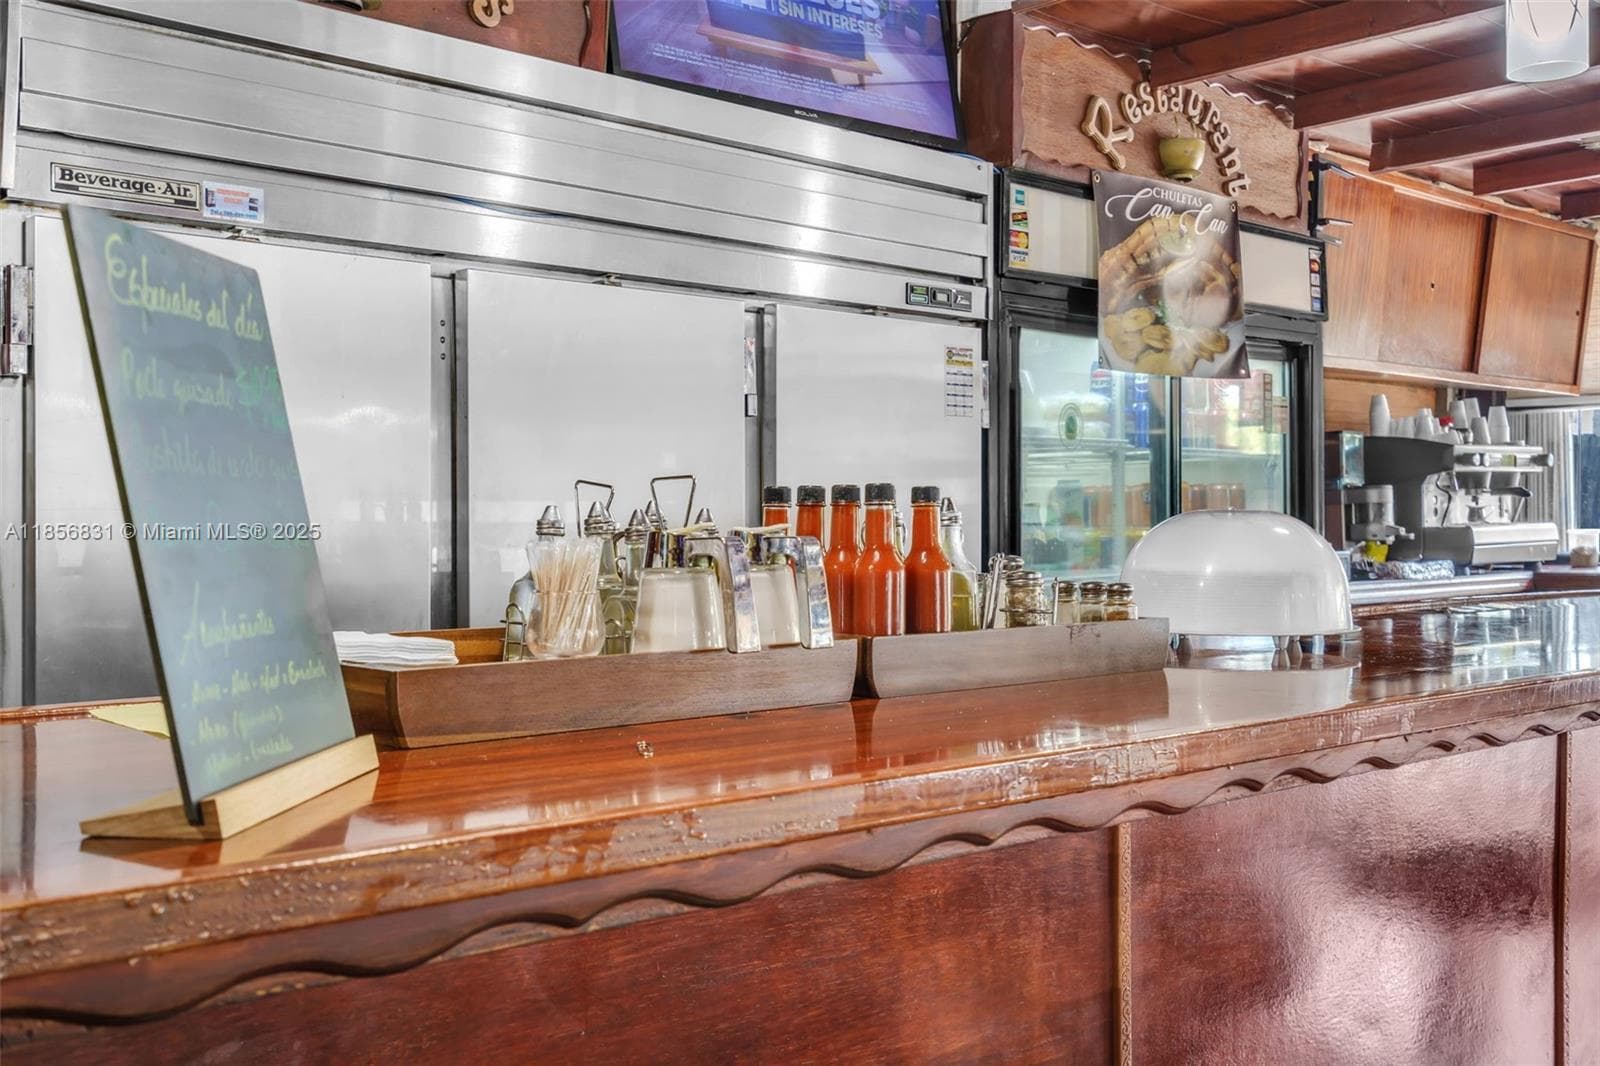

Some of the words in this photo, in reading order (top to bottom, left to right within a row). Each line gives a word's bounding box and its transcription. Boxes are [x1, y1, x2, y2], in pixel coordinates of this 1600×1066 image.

[778, 1, 805, 19] SIN
[808, 7, 883, 39] INTERESES
[1083, 81, 1251, 197] Restaurant
[1105, 188, 1174, 222] Can
[1179, 203, 1228, 236] Can
[1152, 187, 1204, 207] CHULETAS
